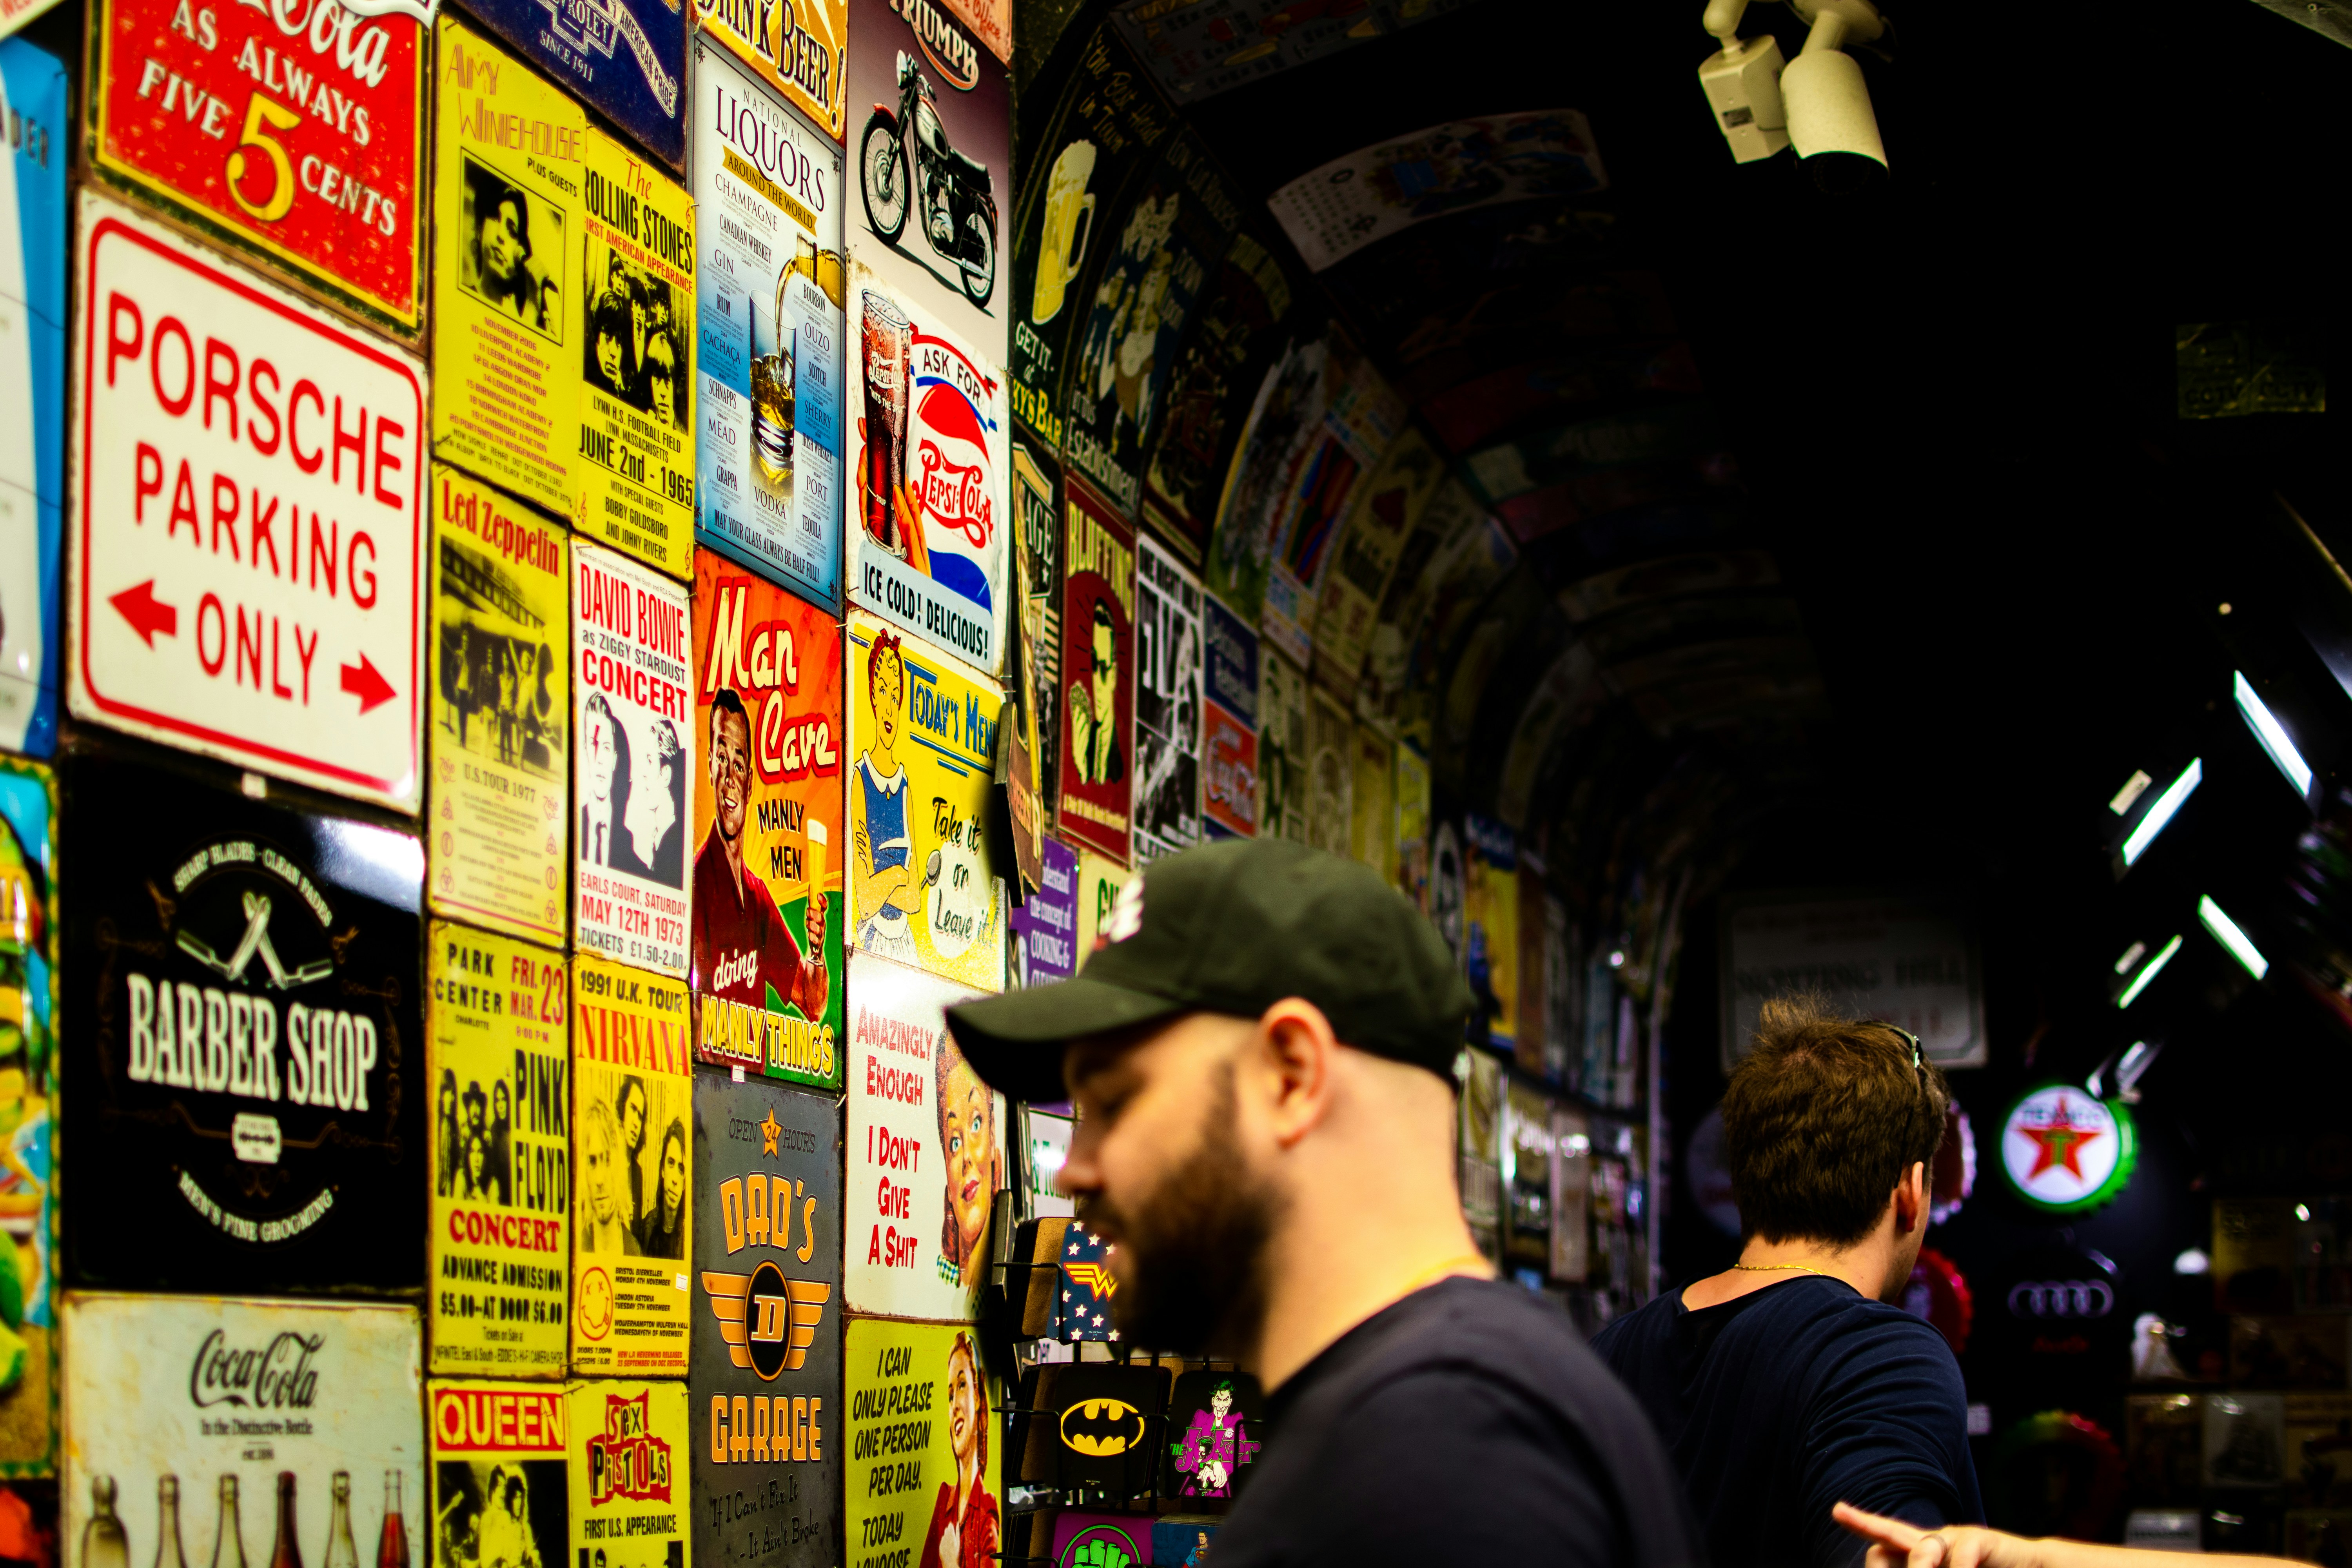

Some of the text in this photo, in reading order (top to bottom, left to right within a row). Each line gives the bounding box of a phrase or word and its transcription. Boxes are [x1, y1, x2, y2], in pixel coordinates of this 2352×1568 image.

[170, 0, 216, 51] AS
[446, 44, 499, 95] AMY
[540, 31, 570, 65] SINCE
[237, 36, 370, 146] ALWAYS
[458, 92, 581, 163] WINEHOUSE
[743, 89, 802, 147] NATIONAL
[138, 58, 231, 140] FIVE
[225, 90, 302, 221] 5
[300, 154, 396, 236] CENTS
[715, 85, 824, 212] LIQUORS
[527, 157, 577, 197] PLUS GUESTS
[626, 158, 652, 200] The
[728, 155, 813, 229] AROUND THE WORLD
[715, 174, 778, 232] CHAMPAGNE
[643, 204, 692, 275] STONES
[606, 229, 692, 295] AMERICAN APPEARANCE
[715, 249, 734, 275] GIN
[717, 293, 731, 318] RUM
[803, 283, 826, 314] BOURBON
[804, 323, 830, 352] OUZO
[1015, 320, 1039, 359] GET
[709, 378, 737, 410] SCHNAPPS
[808, 361, 826, 387] SCOTCH
[923, 349, 981, 407] ASK FOR
[107, 290, 405, 510] PORSCHE
[805, 400, 831, 429] SHERRY
[882, 397, 892, 410] THE
[593, 396, 681, 453] LYNN H.S. FOOTBALL FIELD
[708, 416, 736, 446] MEAD
[802, 432, 813, 450] IRISH
[579, 423, 692, 507] JUNE 2nd 1965
[622, 431, 669, 463] MASSACHUSETTS
[610, 479, 663, 515] WITH SPECIAL GUESTS
[717, 465, 737, 492] GRAPPA
[806, 475, 828, 502] PORT
[605, 497, 668, 540] BOBBY GOLDSBORO
[753, 486, 786, 520] VODKA
[135, 440, 377, 612] PARKING
[443, 479, 559, 577] Led Zeppelin
[606, 521, 667, 563] AND RIVERS
[714, 509, 819, 584] MAY YOUR GLASS ALWAYS BE HALF FULL!
[802, 514, 821, 540] TEQUILA
[603, 561, 625, 574] association
[581, 562, 685, 664] DAVID BOWIE
[865, 562, 988, 661] ICE DELICIOUS!
[197, 592, 318, 707] ONLY
[583, 630, 686, 684] as ZIGGY STARDUST
[706, 586, 797, 692] Man
[583, 649, 687, 723] CONCERT
[761, 690, 836, 773] Cave
[757, 799, 804, 834] MANLY
[933, 796, 981, 855] Take it
[770, 845, 802, 884] MEN
[953, 864, 969, 889] or
[581, 872, 686, 918] EARLS SATURDAY
[935, 889, 973, 941] Leave
[582, 895, 683, 946] MAY 12TH 1973
[448, 942, 494, 977] PARK
[714, 949, 758, 992] doing
[1030, 929, 1062, 968] COOKING
[435, 978, 501, 1015] CENTER
[541, 964, 564, 1026] 23
[581, 970, 682, 1014] 1991 TOUR
[127, 973, 377, 1111] BARBER SHOP
[456, 1014, 489, 1030] CHARLOTTE
[577, 1003, 690, 1077] NIRVANA
[702, 994, 835, 1079] MANLY THINGS
[857, 1004, 933, 1061] AMAZINGLY
[515, 1049, 564, 1137] PINK
[867, 1054, 923, 1106] ENOUGH
[729, 1117, 816, 1154] OPEN 24 HOURS
[868, 1125, 920, 1173] I DON'T
[516, 1140, 566, 1214] FLOYD
[878, 1176, 911, 1220] GIVE
[449, 1209, 560, 1253] CONCERT
[868, 1224, 918, 1269] A SHIT
[443, 1254, 562, 1292] ADVANCE ADMISSION
[500, 1296, 530, 1322] DOOR
[878, 1346, 911, 1379] I CAN
[438, 1393, 565, 1446] QUEEN
[853, 1381, 934, 1422] ONLY PLEASE
[285, 1418, 314, 1435] Bottle
[711, 1392, 822, 1465] GARAGE
[854, 1420, 931, 1461] ONE PERSON
[869, 1460, 922, 1498] PER DAY.
[585, 1514, 677, 1539] FIRST U.S. APPEARANCE
[712, 1474, 798, 1537] If I Can't Fix It
[748, 1507, 819, 1559] It Ain't Broke
[863, 1511, 903, 1548] TODAY
